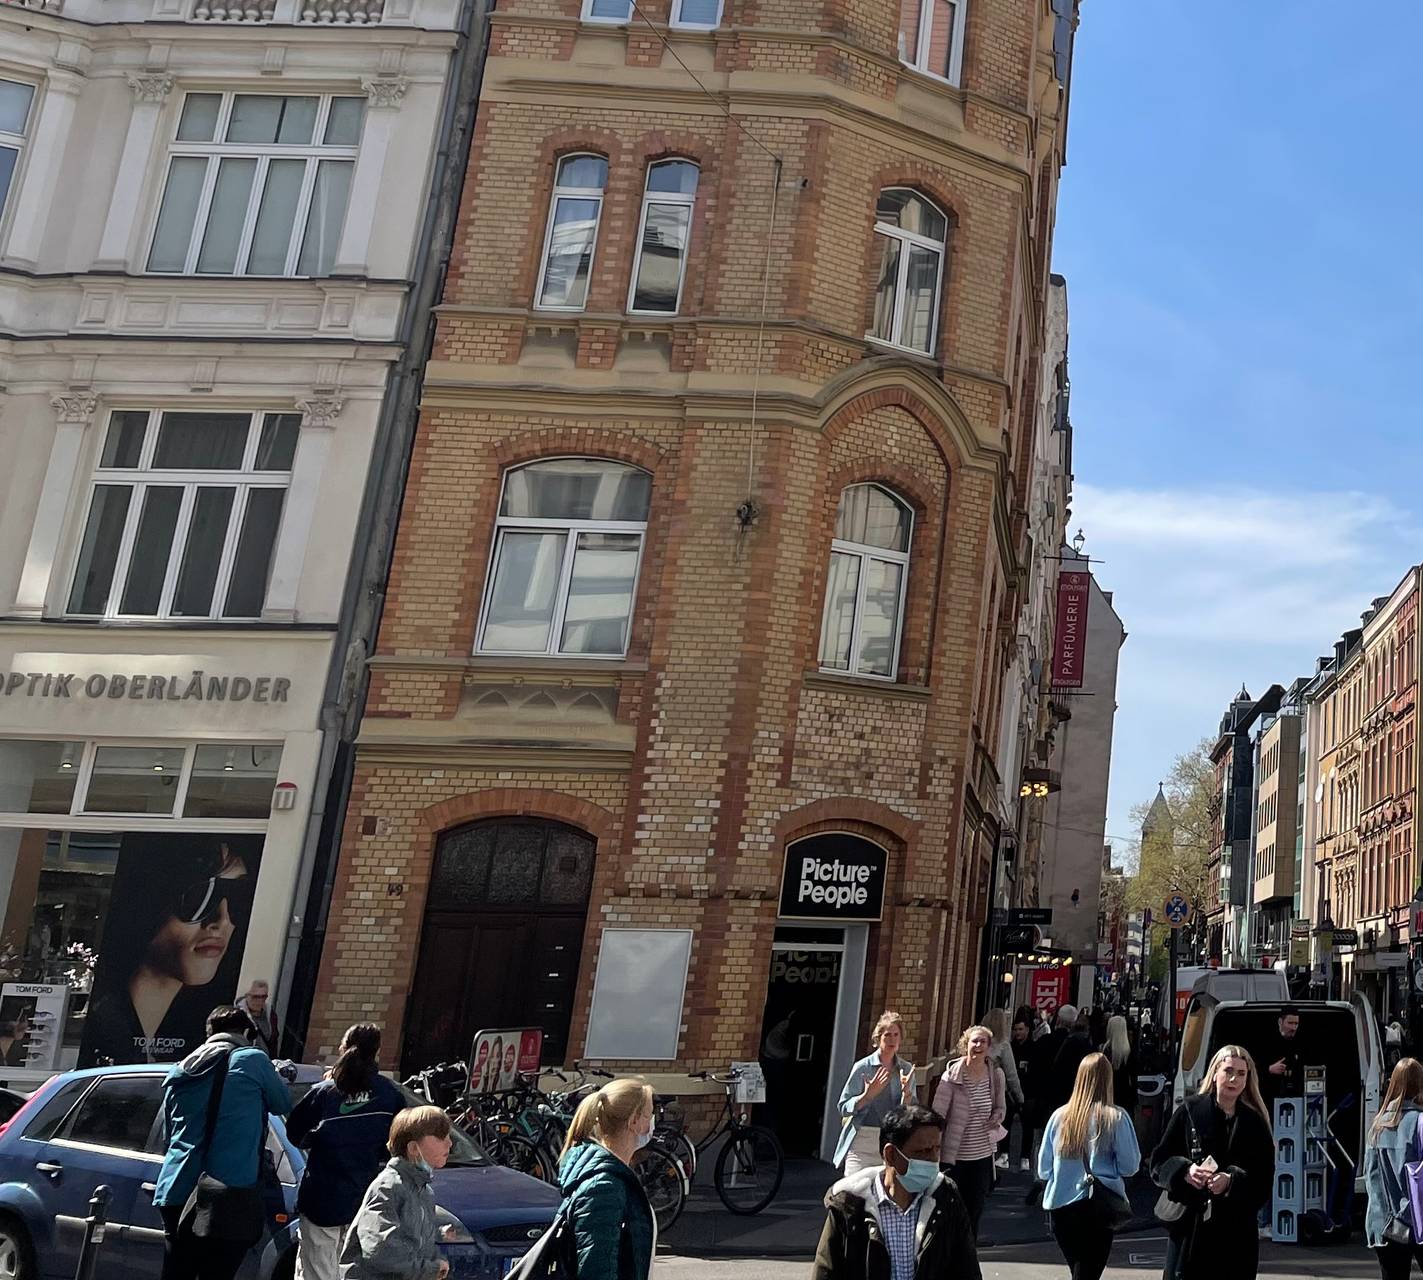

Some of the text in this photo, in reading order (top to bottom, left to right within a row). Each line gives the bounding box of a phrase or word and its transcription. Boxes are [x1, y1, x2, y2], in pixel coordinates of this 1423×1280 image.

[1062, 595, 1079, 675] PARFÜMERIE
[85, 670, 291, 702] OBERLÄNDER
[800, 857, 870, 883] Picture
[798, 880, 868, 909] People
[16, 985, 53, 994] TOM FORD
[133, 1036, 186, 1048] TOM FORD
